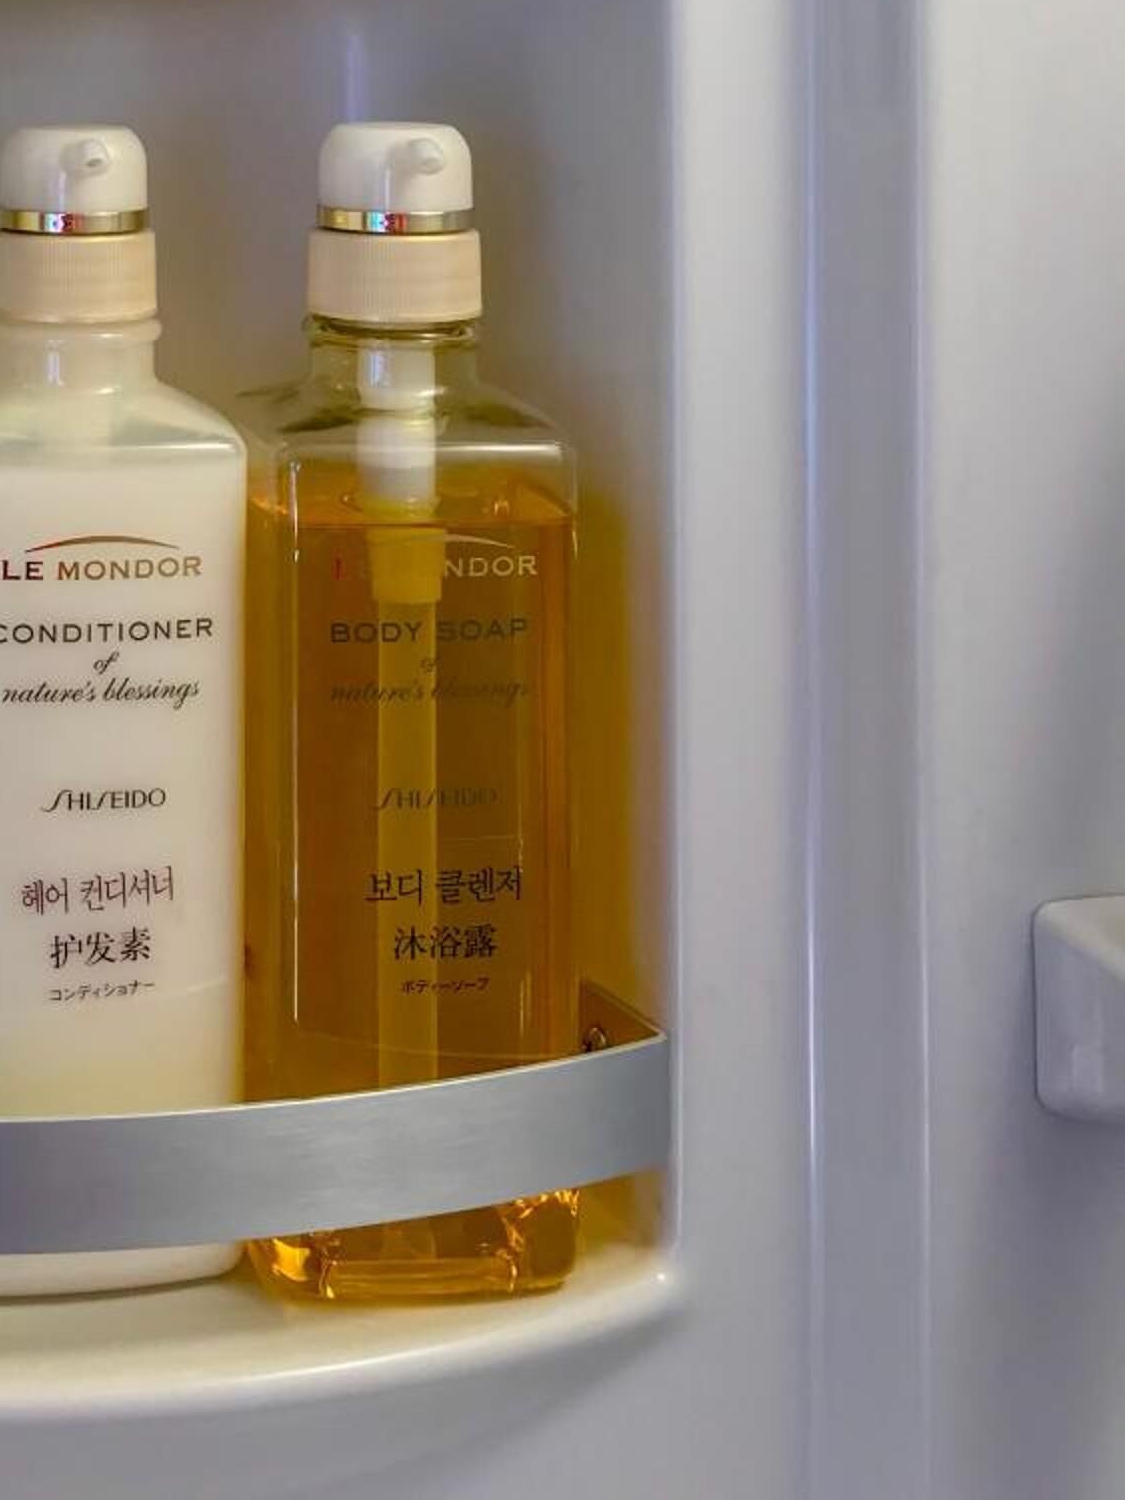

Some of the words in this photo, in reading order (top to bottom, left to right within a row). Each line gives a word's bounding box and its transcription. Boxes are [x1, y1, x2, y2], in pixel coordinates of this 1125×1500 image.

[1, 558, 44, 581] LE
[58, 555, 203, 581] MONDOR
[330, 621, 422, 644] BODY
[436, 617, 528, 642] SOAP
[92, 651, 120, 676] of
[1, 680, 97, 704] nature's
[102, 676, 200, 711] blessings
[41, 787, 167, 813] SHISEIDO
[22, 877, 69, 916] 헤어
[80, 865, 174, 912] 컨디셔너
[365, 869, 423, 907] 보디
[436, 864, 524, 905] 클렌저
[50, 925, 152, 970] 护发素
[393, 923, 498, 961] 沐浴露
[49, 979, 156, 1002] コンディショナー
